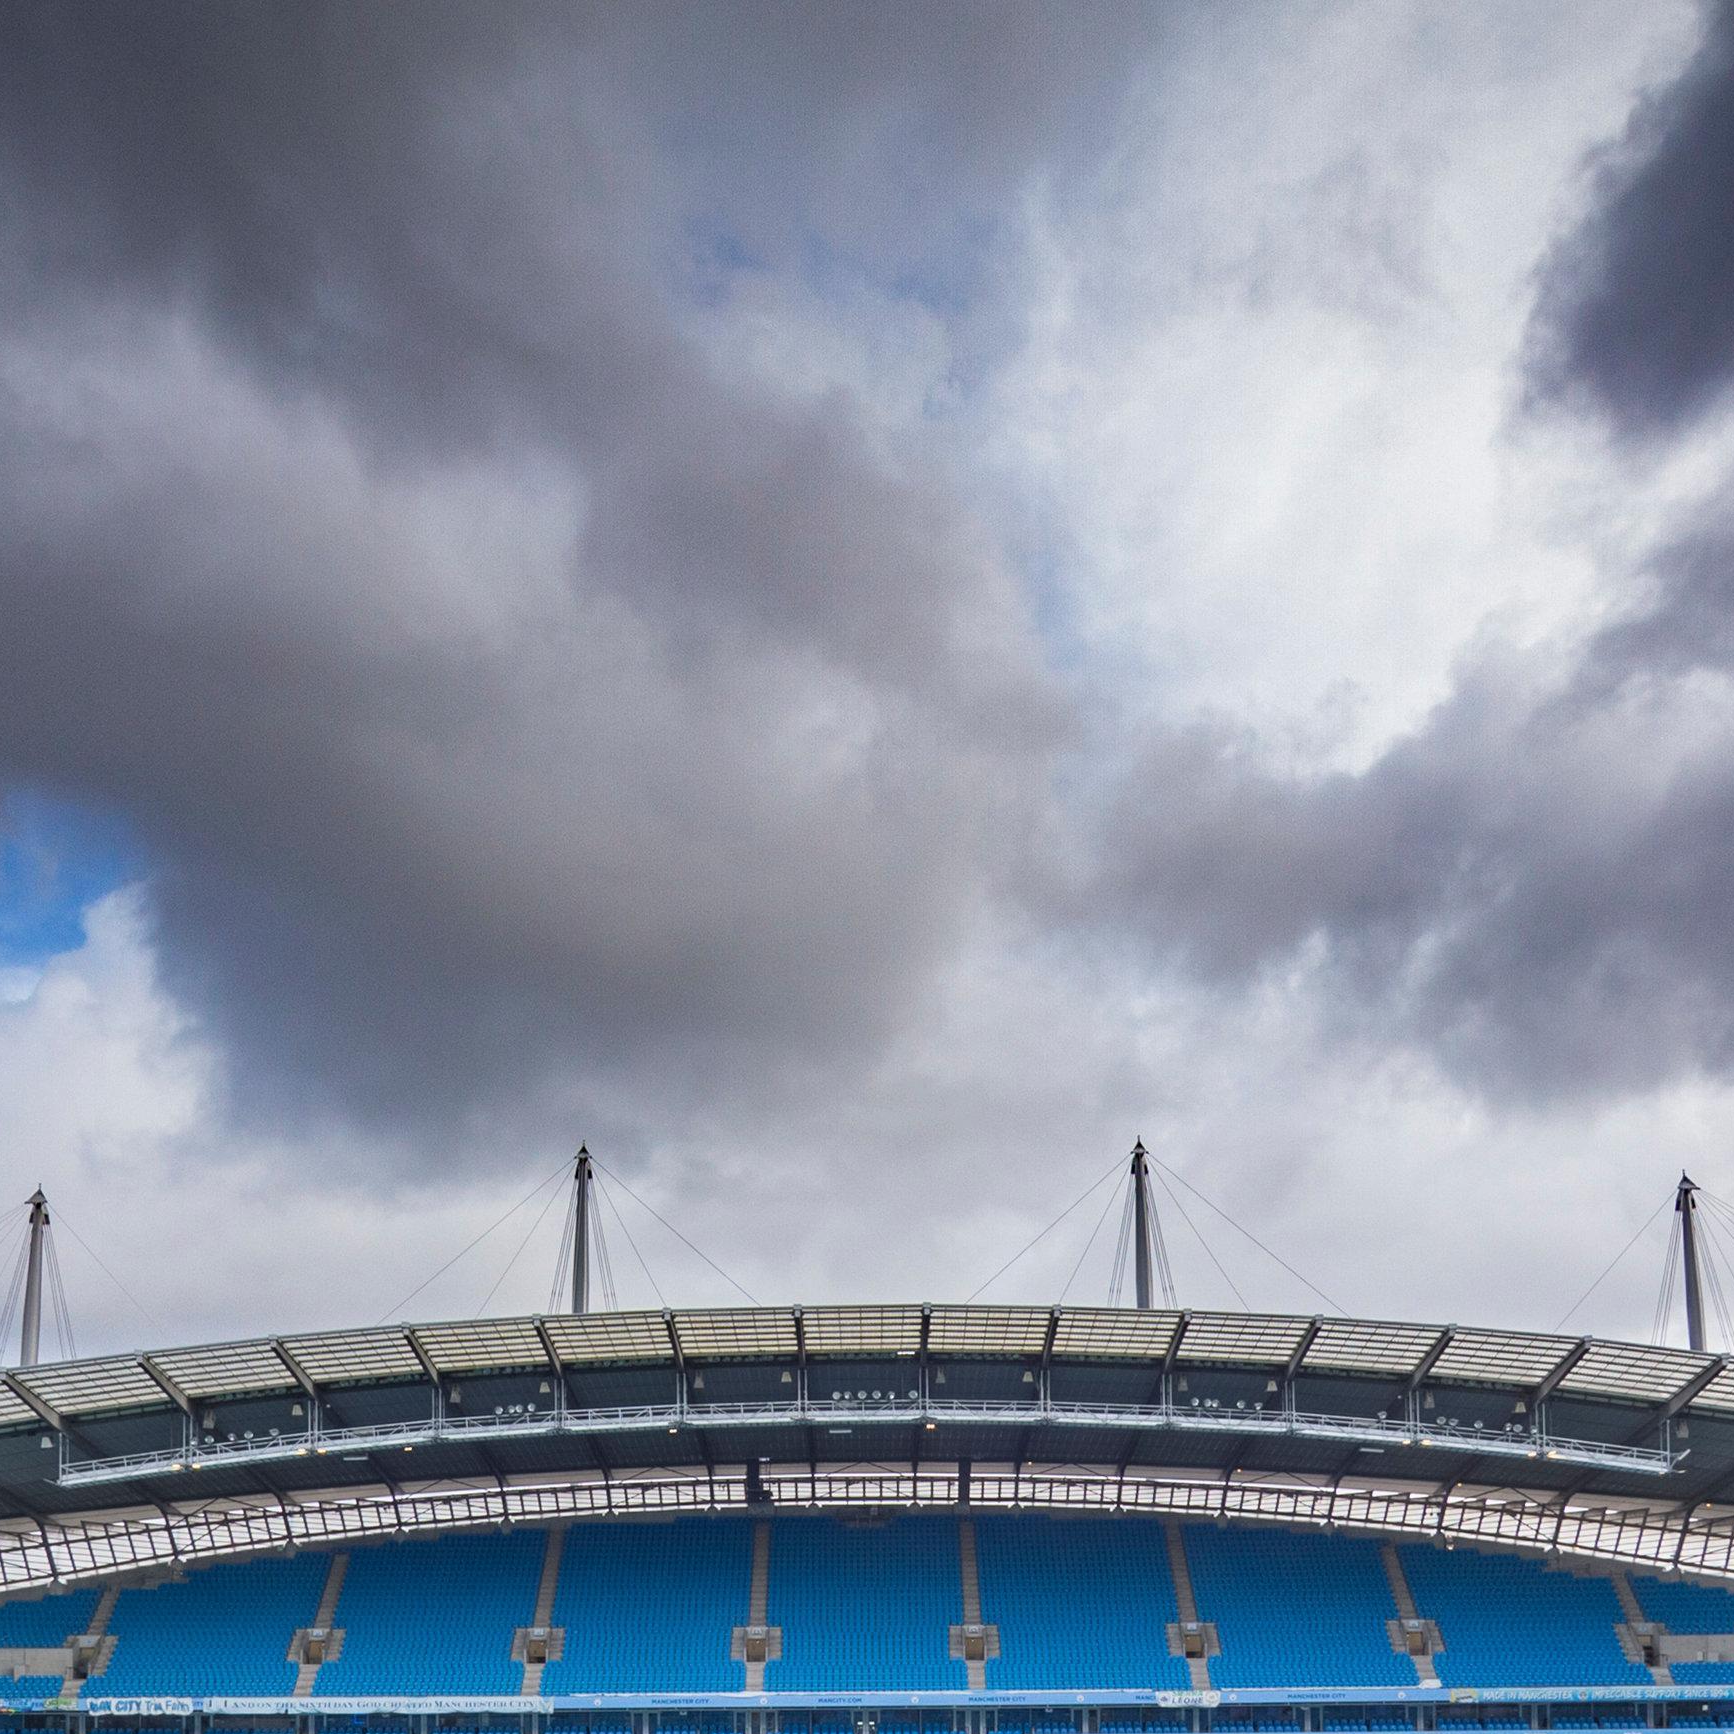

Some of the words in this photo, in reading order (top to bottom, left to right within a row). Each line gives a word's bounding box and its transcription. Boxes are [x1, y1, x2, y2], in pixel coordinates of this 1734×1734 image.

[1518, 1690, 1573, 1700] MANCHESTER
[1683, 1689, 1708, 1698] SINCE
[435, 1700, 507, 1709] MANCHESTER
[510, 1700, 534, 1708] CITY
